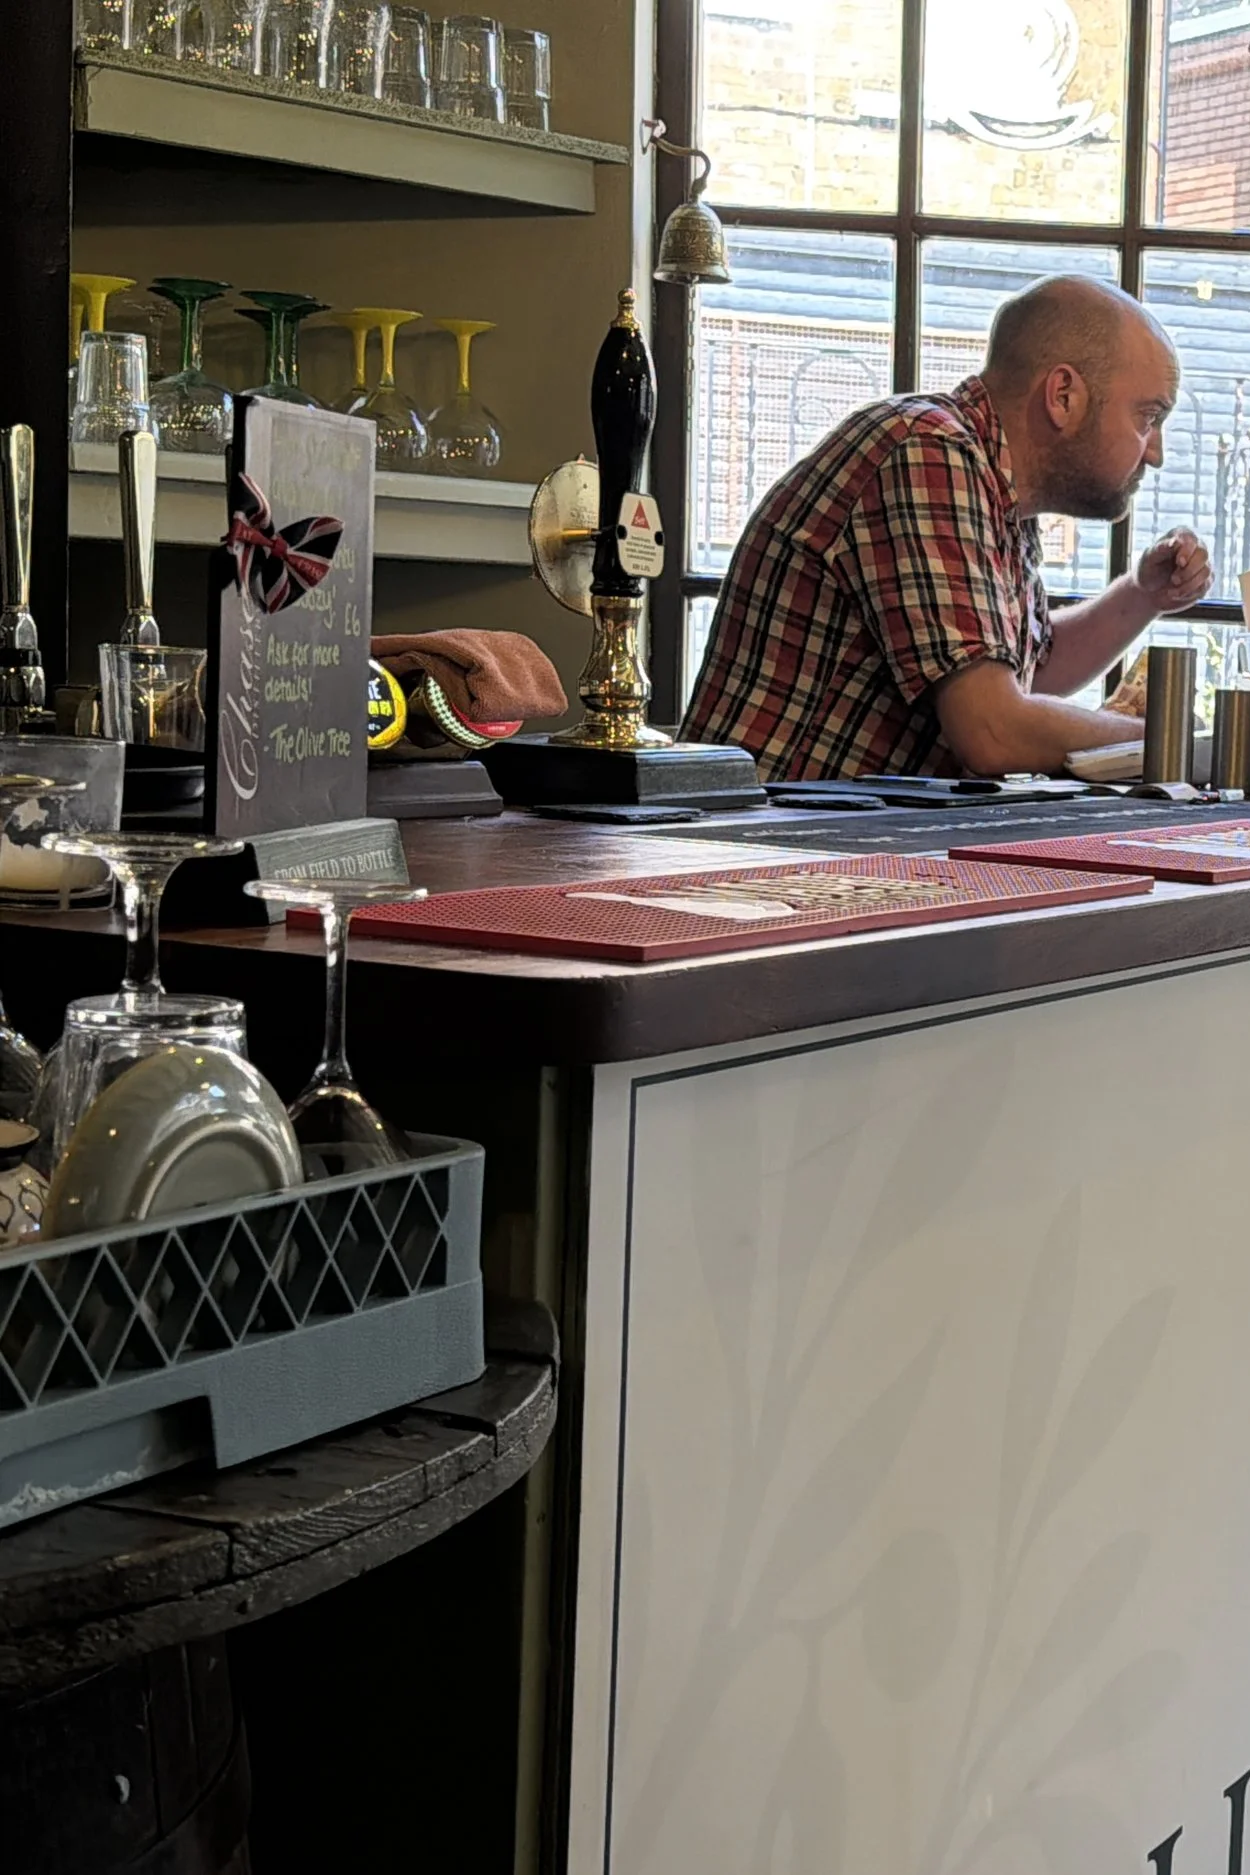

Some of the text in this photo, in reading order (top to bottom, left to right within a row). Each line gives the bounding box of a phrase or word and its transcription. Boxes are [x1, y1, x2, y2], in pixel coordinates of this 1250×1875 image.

[267, 634, 341, 671] Ask for more
[265, 675, 312, 712] details!
[269, 723, 352, 765] The Olive Tree
[308, 858, 341, 879] FIELD
[341, 855, 356, 876] TO
[358, 848, 395, 873] BOTTLE
